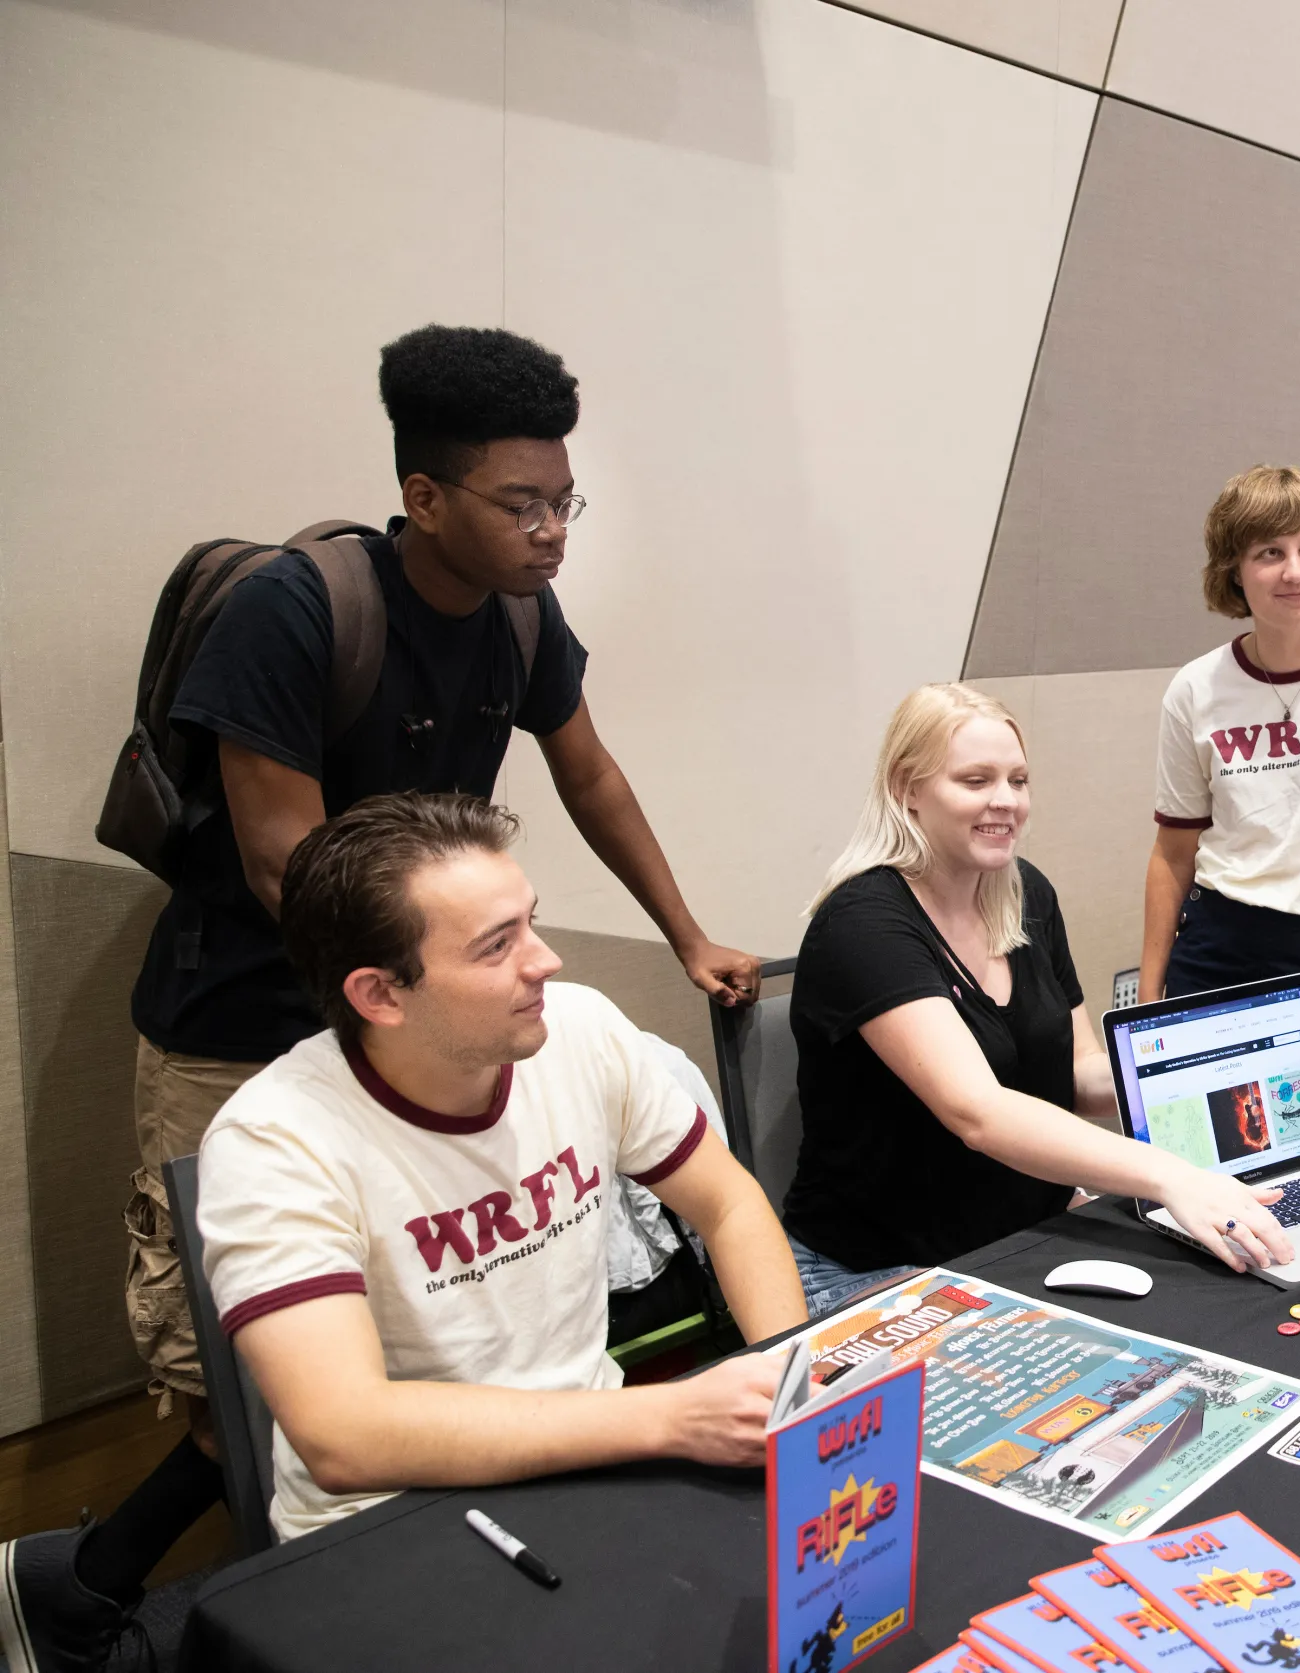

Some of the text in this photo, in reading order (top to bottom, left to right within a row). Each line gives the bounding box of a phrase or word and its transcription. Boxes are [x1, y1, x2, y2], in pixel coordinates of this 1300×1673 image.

[1220, 767, 1233, 776] the
[1237, 765, 1259, 774] only
[1140, 1038, 1164, 1054] wrfl
[1214, 1061, 1243, 1073] Latest Posts
[404, 1145, 600, 1273] WRFL
[426, 1279, 446, 1294] the
[450, 1269, 485, 1285] only
[946, 1330, 985, 1353] HORSE
[978, 1306, 1028, 1333] FEATHERS
[818, 1396, 883, 1464] wrfl
[1151, 1531, 1227, 1562] wrfl
[797, 1537, 898, 1609] summer 2019 edition
[1184, 1554, 1220, 1567] presents
[1213, 1614, 1255, 1629] summer
[1257, 1605, 1281, 1619] 2019
